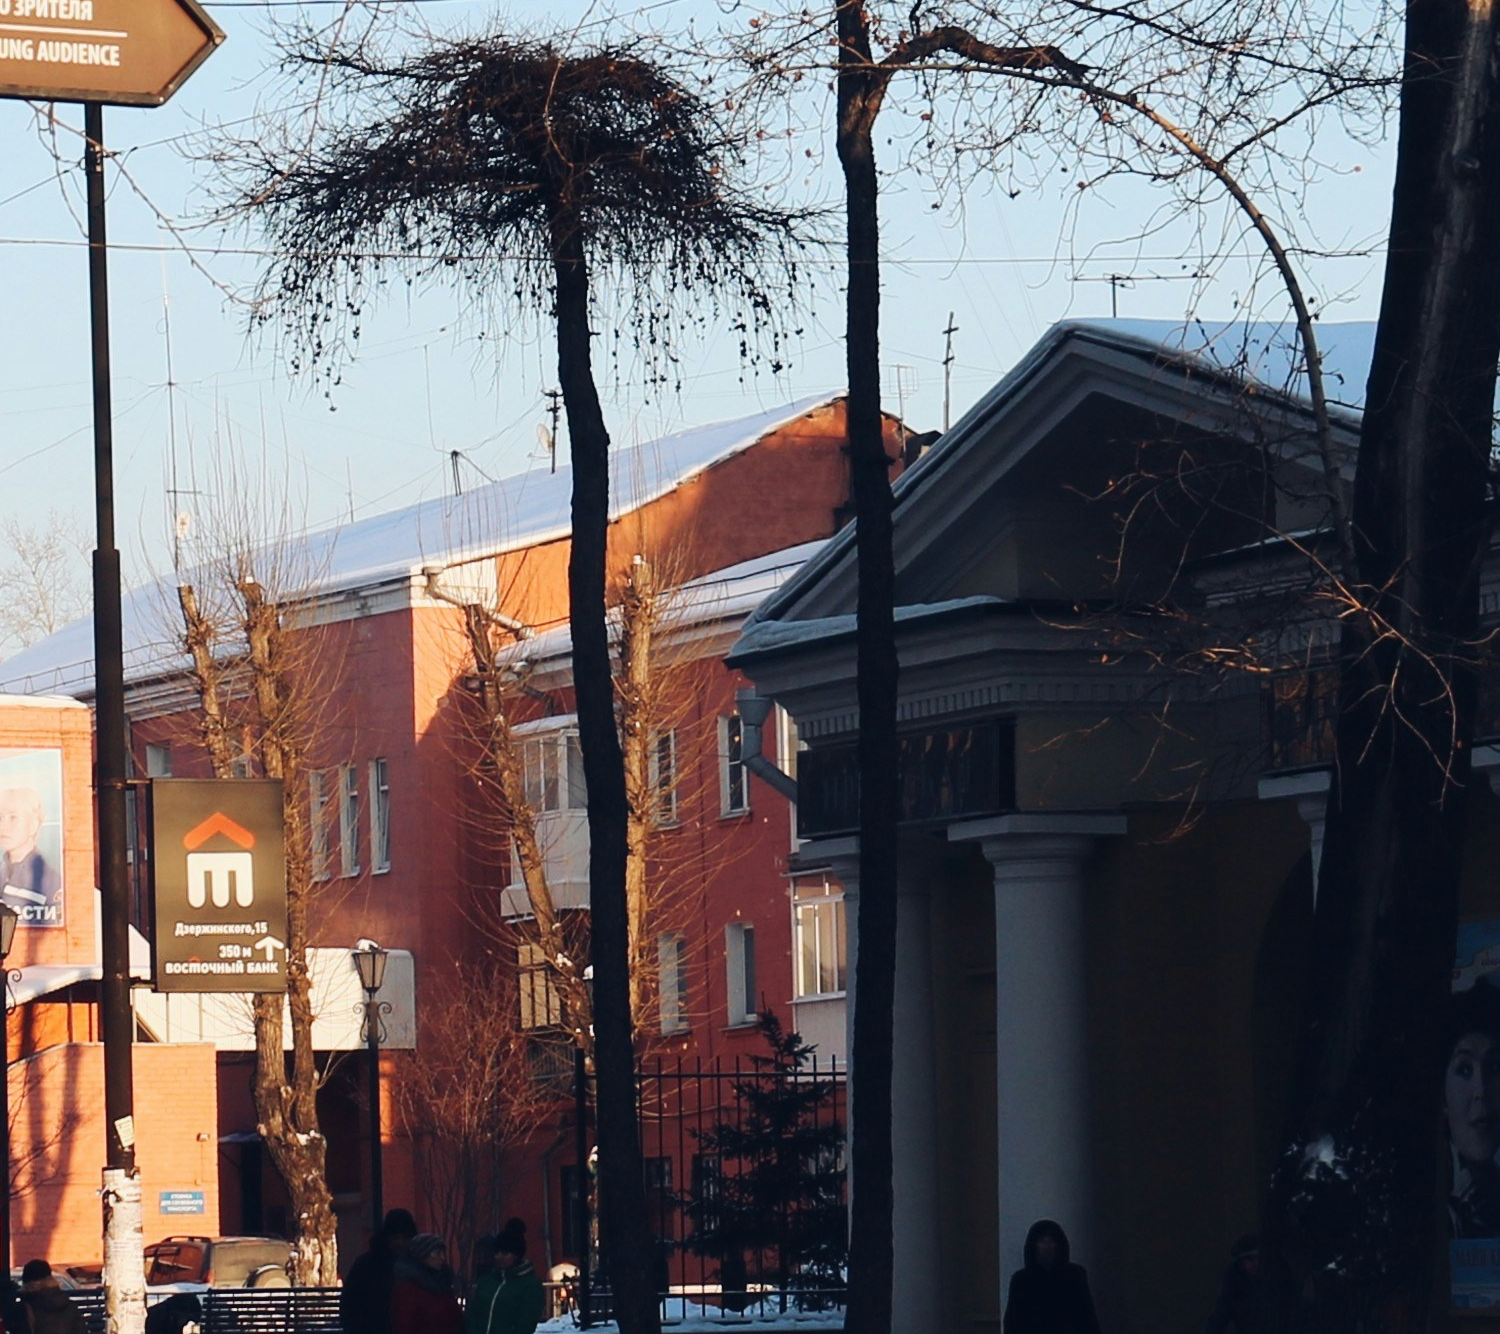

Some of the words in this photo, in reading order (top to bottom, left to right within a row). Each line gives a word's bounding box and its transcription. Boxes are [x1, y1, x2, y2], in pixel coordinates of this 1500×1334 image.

[36, 39, 120, 68] AUDIENCE
[218, 944, 241, 959] 350
[246, 962, 280, 975] БАНК
